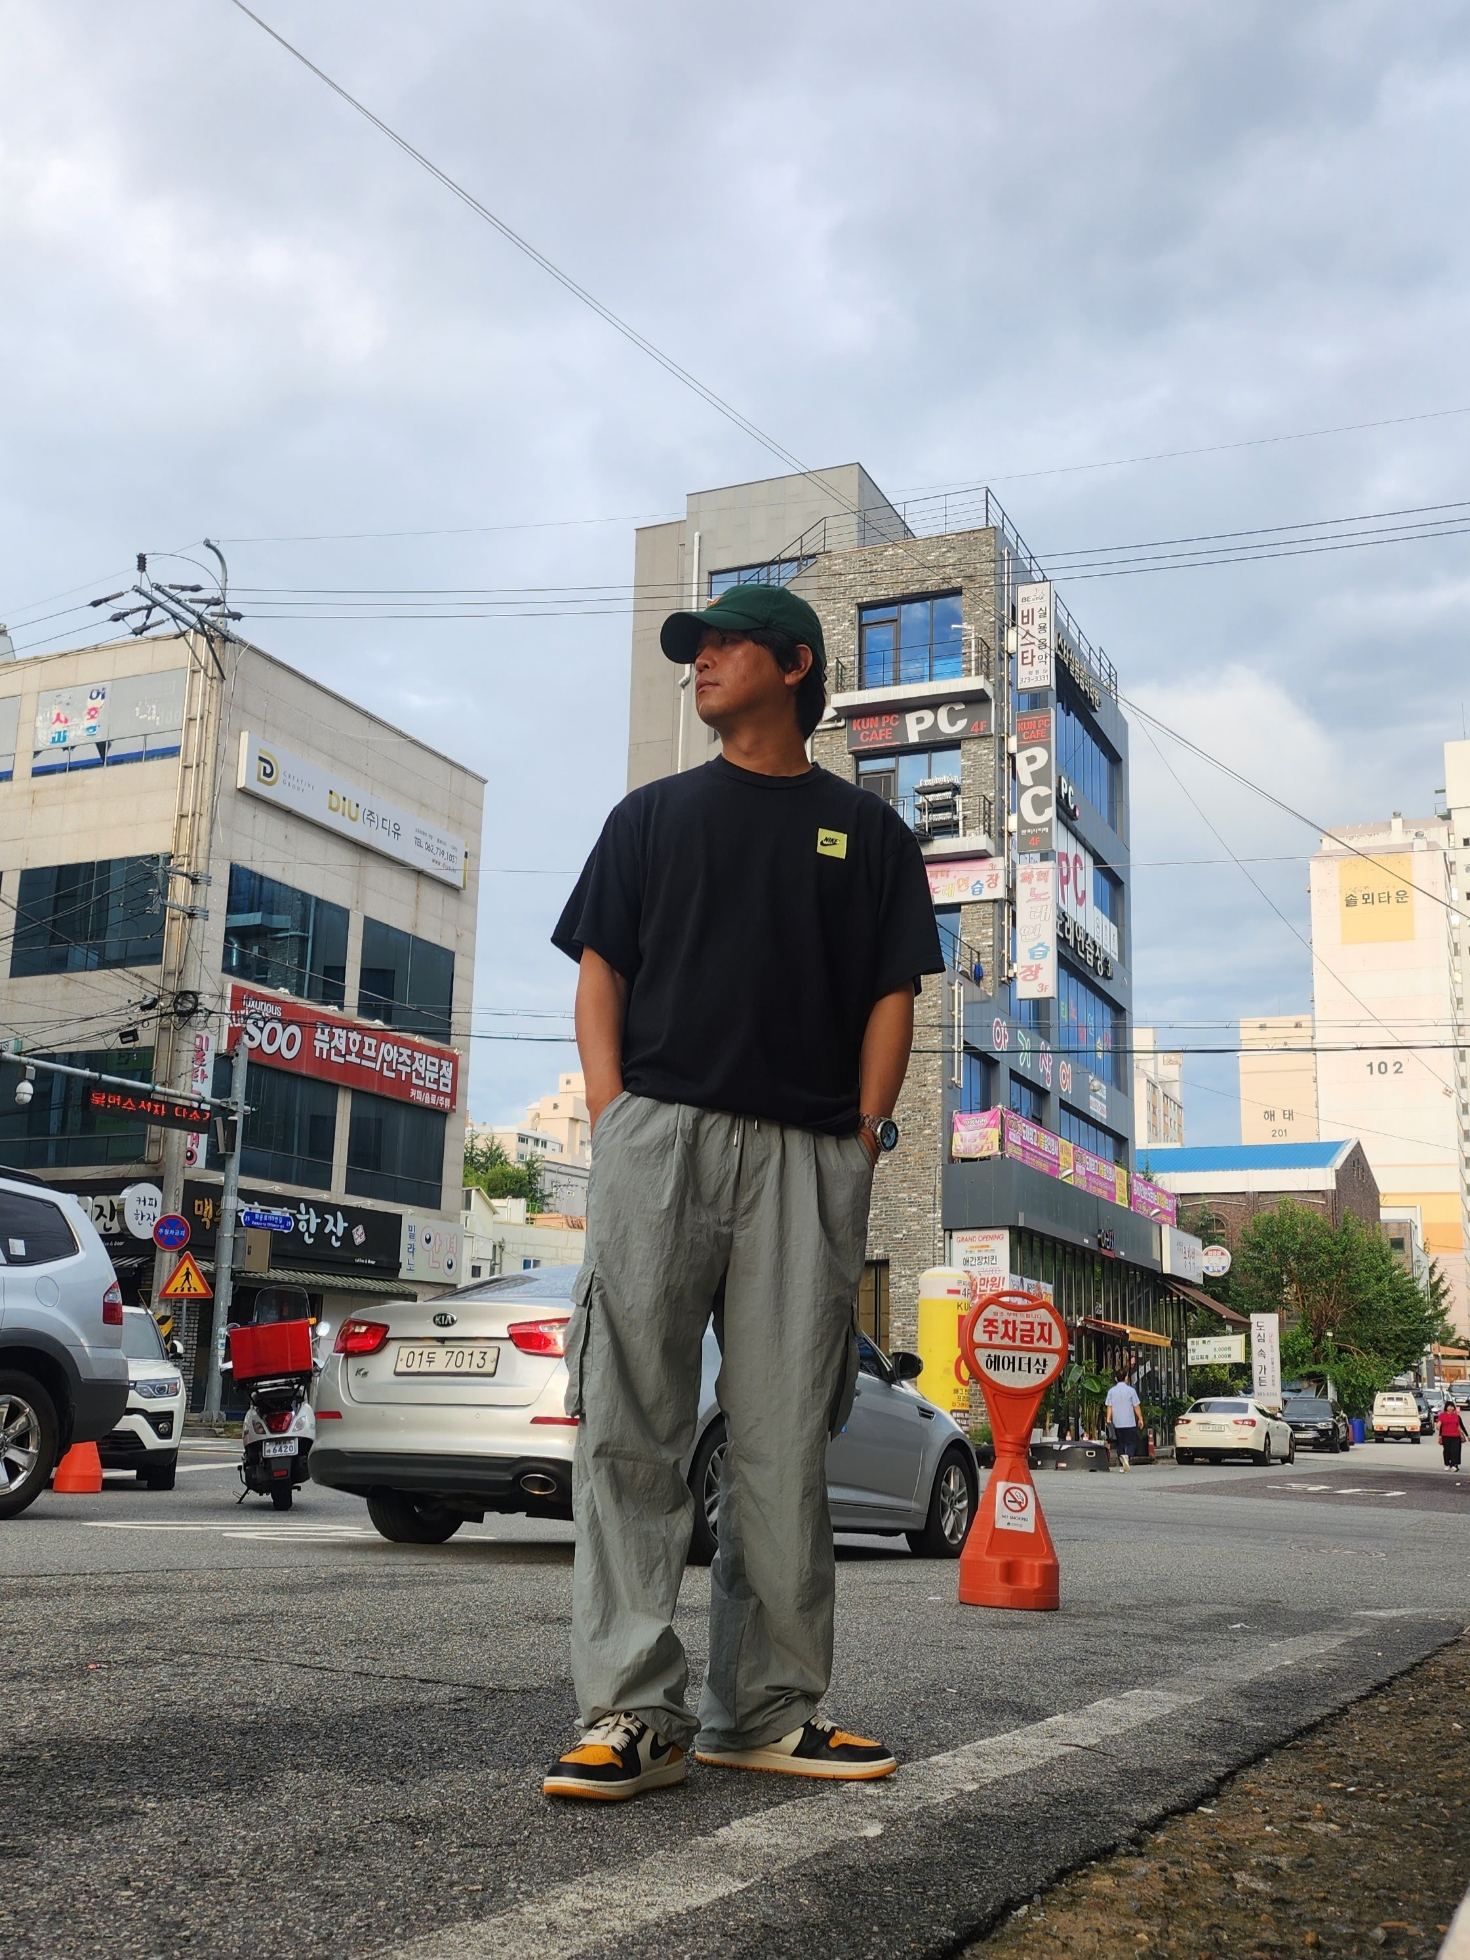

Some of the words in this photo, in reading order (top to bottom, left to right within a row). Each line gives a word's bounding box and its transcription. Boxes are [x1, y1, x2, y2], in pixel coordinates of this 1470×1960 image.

[1020, 607, 1036, 667] 비스타
[852, 716, 879, 731] KUN
[881, 714, 900, 727] PC
[904, 701, 968, 743] PC
[970, 721, 987, 733] 4F
[1017, 720, 1037, 732] KUN
[1037, 719, 1051, 728] PC
[860, 728, 893, 743] CAFE
[1022, 728, 1047, 740] CAFE
[1016, 746, 1053, 825] PC
[1061, 775, 1075, 809] PC
[1028, 837, 1041, 847] 4F
[930, 872, 1000, 898] 노래연습장
[1057, 851, 1087, 907] PC
[1344, 889, 1411, 908] 솔뫼타운
[1036, 982, 1050, 993] 3F
[243, 1017, 302, 1060] SOO
[1366, 1060, 1404, 1076] 102
[1263, 1108, 1295, 1122] 해태
[1271, 1129, 1288, 1138] 201
[135, 1196, 158, 1208] 커피
[133, 1208, 158, 1227] 한잔
[295, 1202, 349, 1248] 한잔
[956, 1235, 977, 1243] GRAND
[977, 1233, 1005, 1242] OPENING
[406, 1224, 416, 1272] 밀라노
[434, 1314, 452, 1325] KIA
[983, 1318, 1053, 1346] 주차금지
[1256, 1321, 1266, 1343] 도심
[405, 1350, 437, 1369] 01두
[445, 1350, 488, 1369] 7013
[1257, 1364, 1268, 1387] 가든
[272, 1444, 294, 1454] 6420
